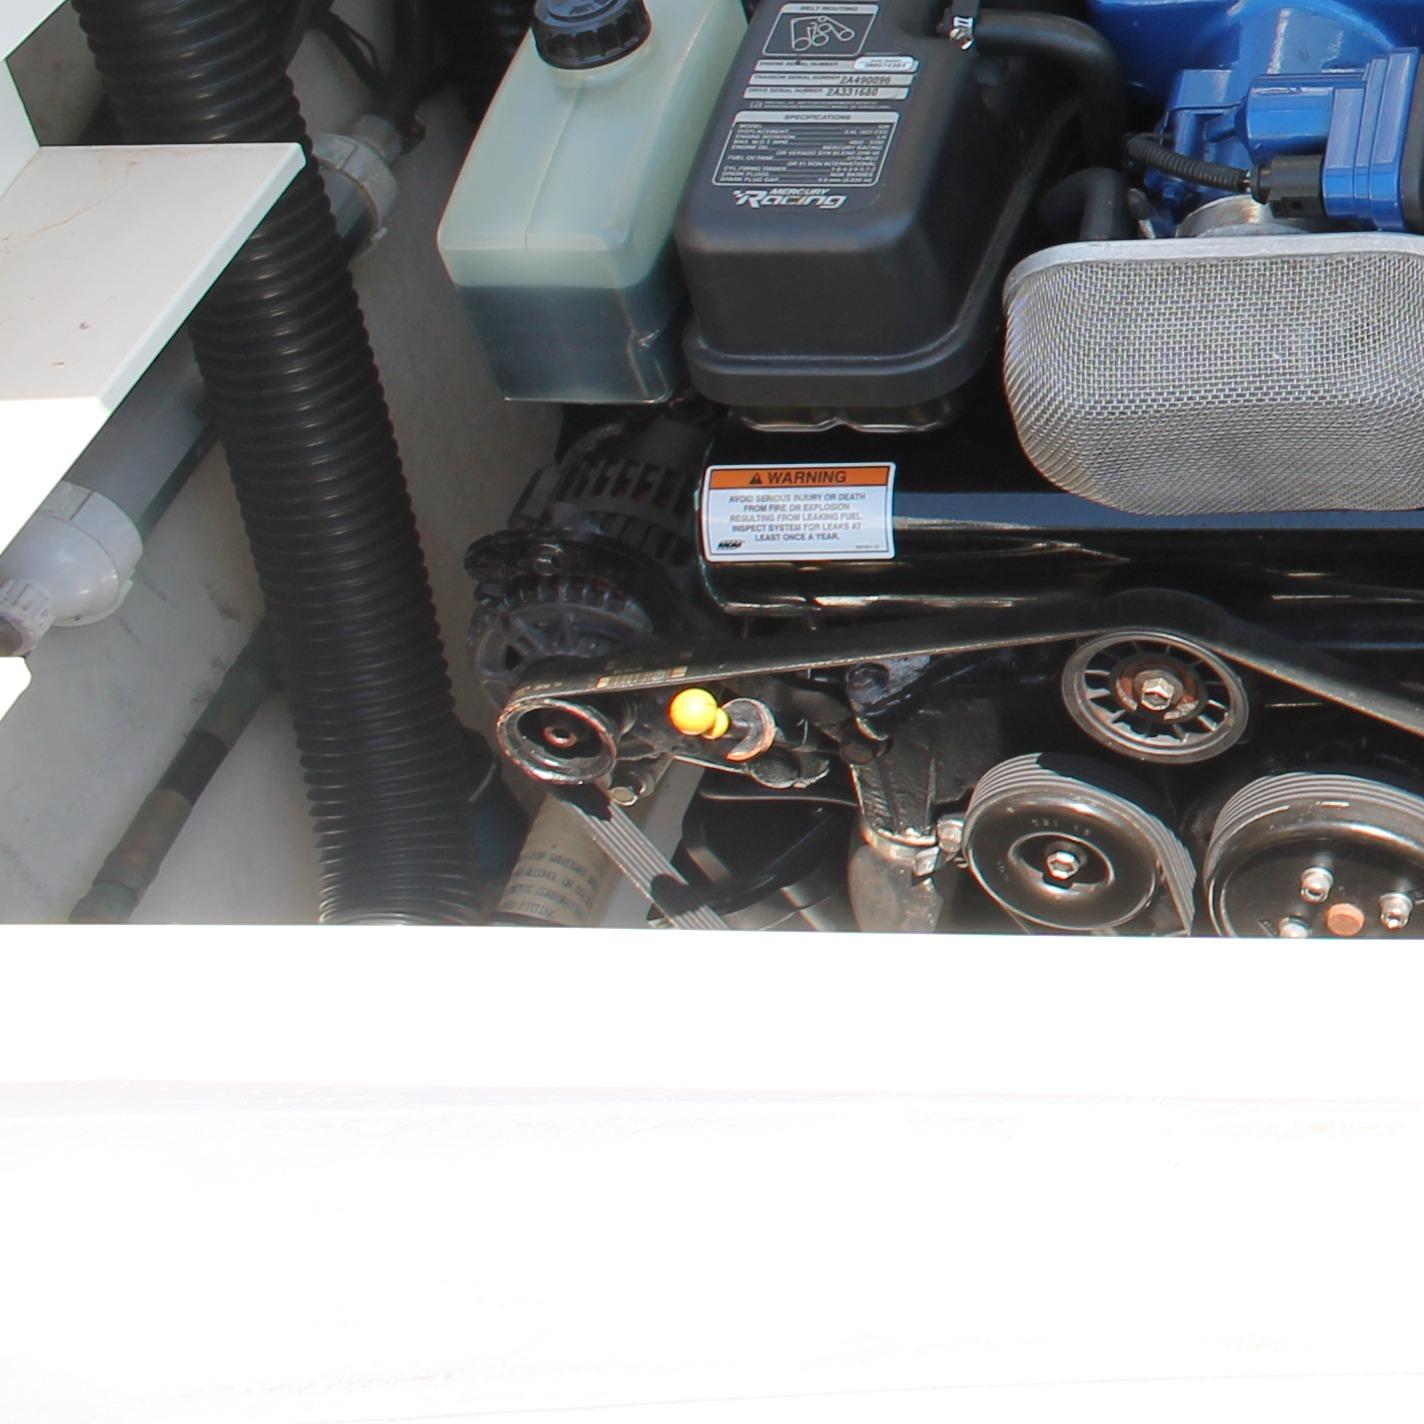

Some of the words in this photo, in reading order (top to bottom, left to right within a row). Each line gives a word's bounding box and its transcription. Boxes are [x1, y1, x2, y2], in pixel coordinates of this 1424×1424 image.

[769, 187, 830, 196] MERCURY
[734, 189, 848, 209] Racing
[767, 470, 848, 485] WARNING
[729, 495, 754, 504] AVOID
[756, 494, 792, 503] SERIOUS
[793, 493, 822, 502] INJURY
[824, 493, 837, 501] OR
[838, 492, 866, 501] DEATH
[744, 504, 767, 513] FROM
[769, 504, 788, 512] FIRE
[789, 503, 802, 512] OR
[803, 502, 850, 511] EXPLOSION
[729, 514, 775, 523] RESULTING
[777, 514, 800, 522] FROM
[802, 513, 838, 521] LEAKING
[732, 524, 766, 533] INSPECT
[768, 523, 802, 532] SYSTEM
[803, 523, 821, 531] FOR
[822, 522, 850, 531] LEAKS
[851, 522, 862, 531] AT
[755, 533, 781, 542] LEAST
[783, 532, 806, 541] ONCE
[807, 532, 814, 541] A
[816, 531, 840, 541] YEAR.
